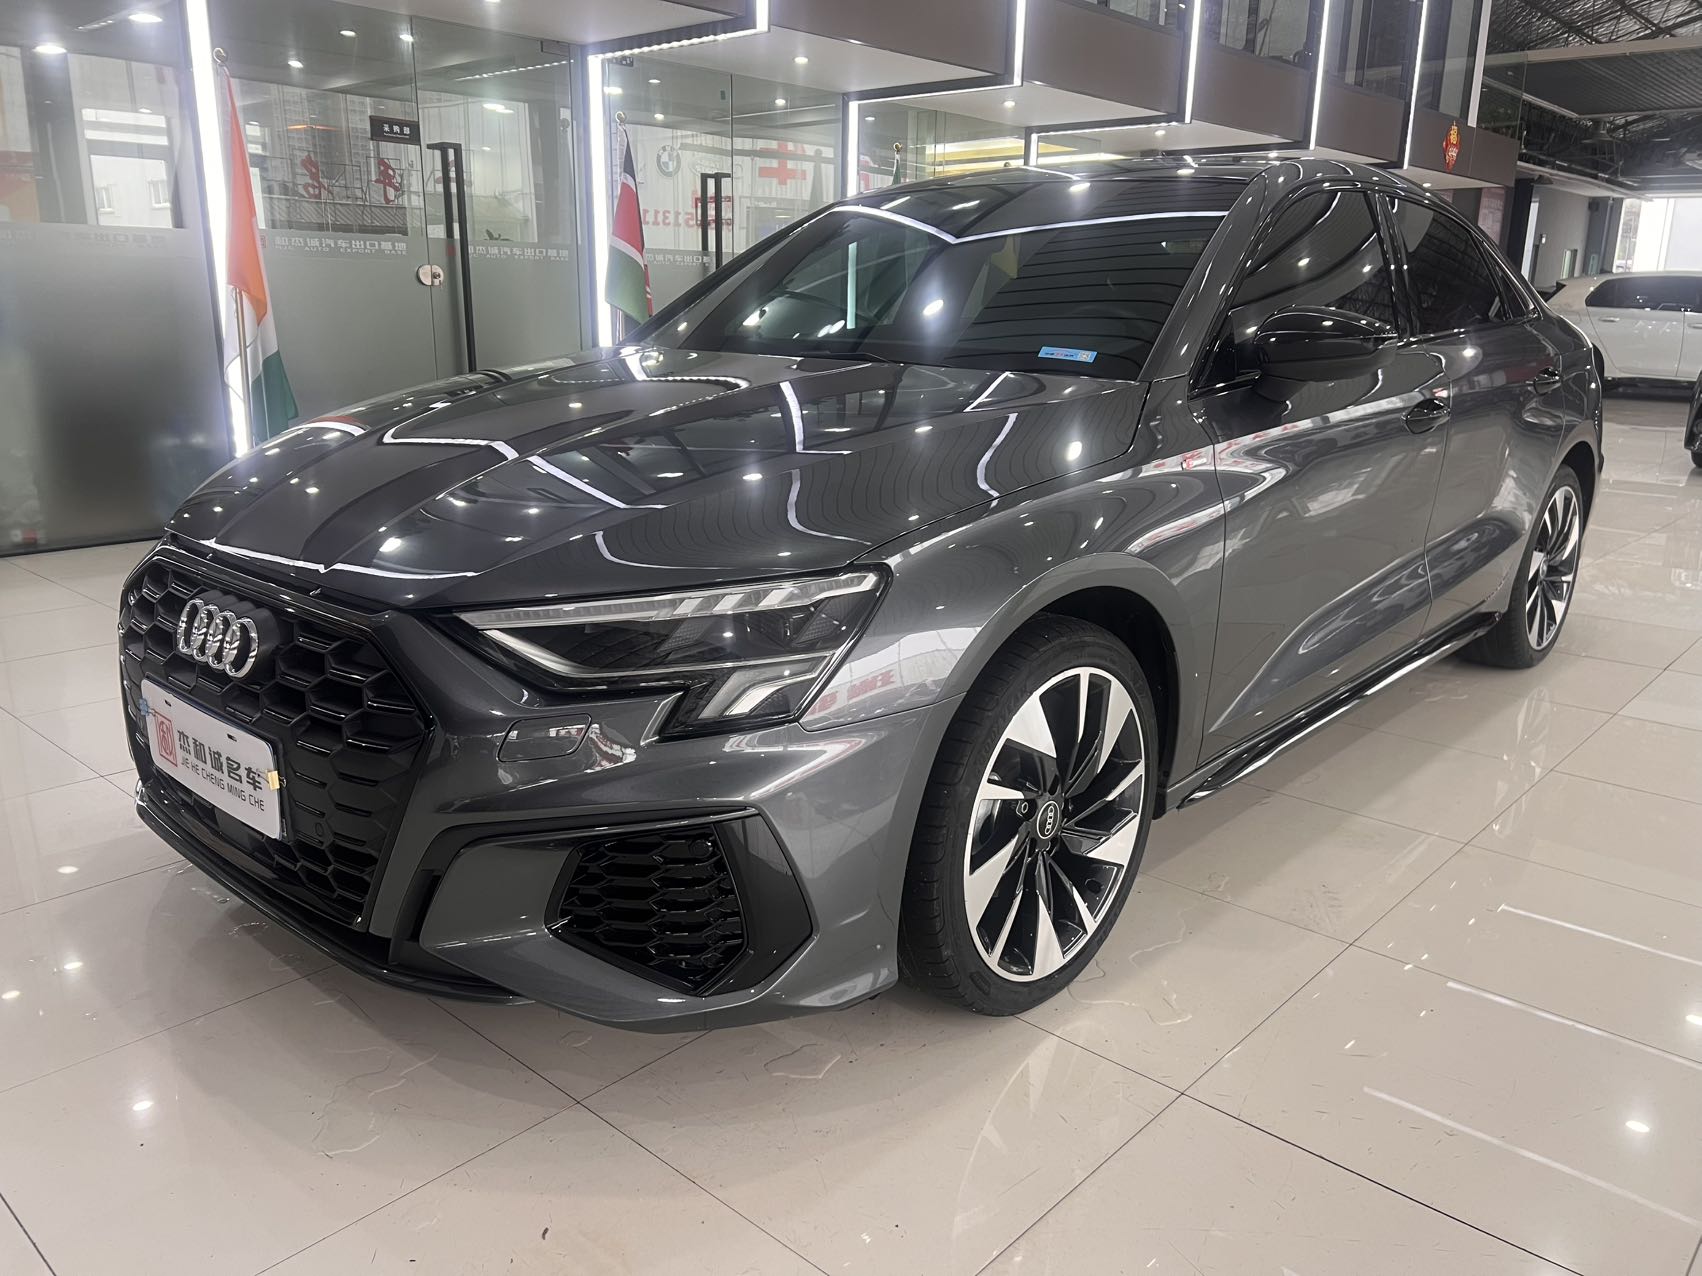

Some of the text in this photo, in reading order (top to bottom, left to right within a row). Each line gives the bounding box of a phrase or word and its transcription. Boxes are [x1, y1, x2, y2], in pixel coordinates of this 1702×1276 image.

[177, 729, 263, 792] 杰和诚名车
[181, 756, 265, 812] JIE HE CHENG MING CHE
